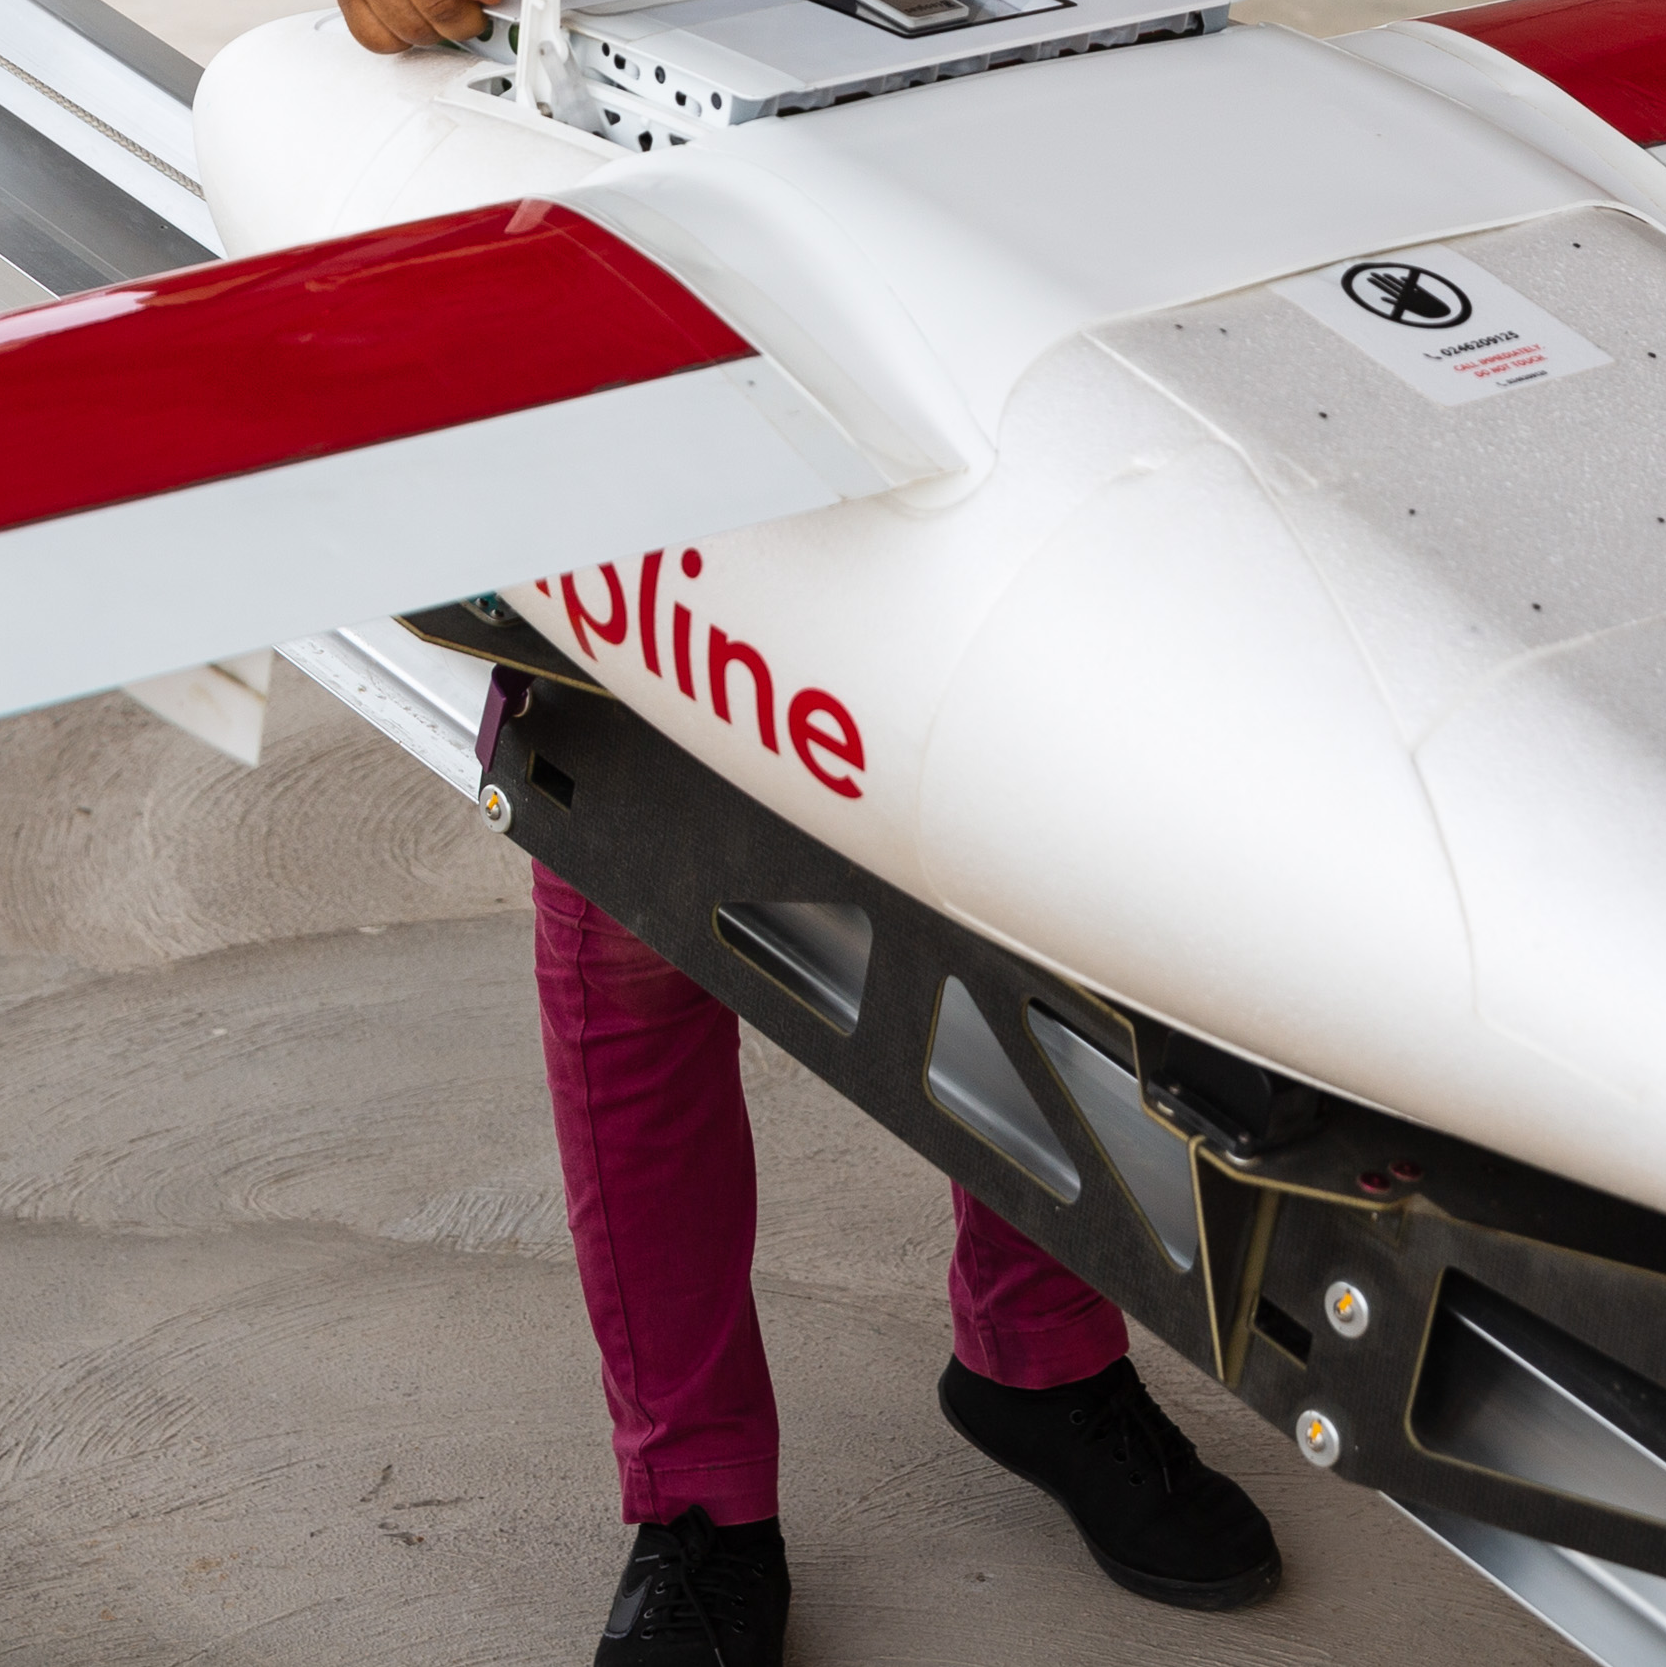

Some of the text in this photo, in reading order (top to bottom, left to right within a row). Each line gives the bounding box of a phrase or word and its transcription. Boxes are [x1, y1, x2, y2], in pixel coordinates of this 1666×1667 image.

[1453, 362, 1479, 372] CALL
[1474, 369, 1491, 378] DO
[535, 547, 866, 800] pline
